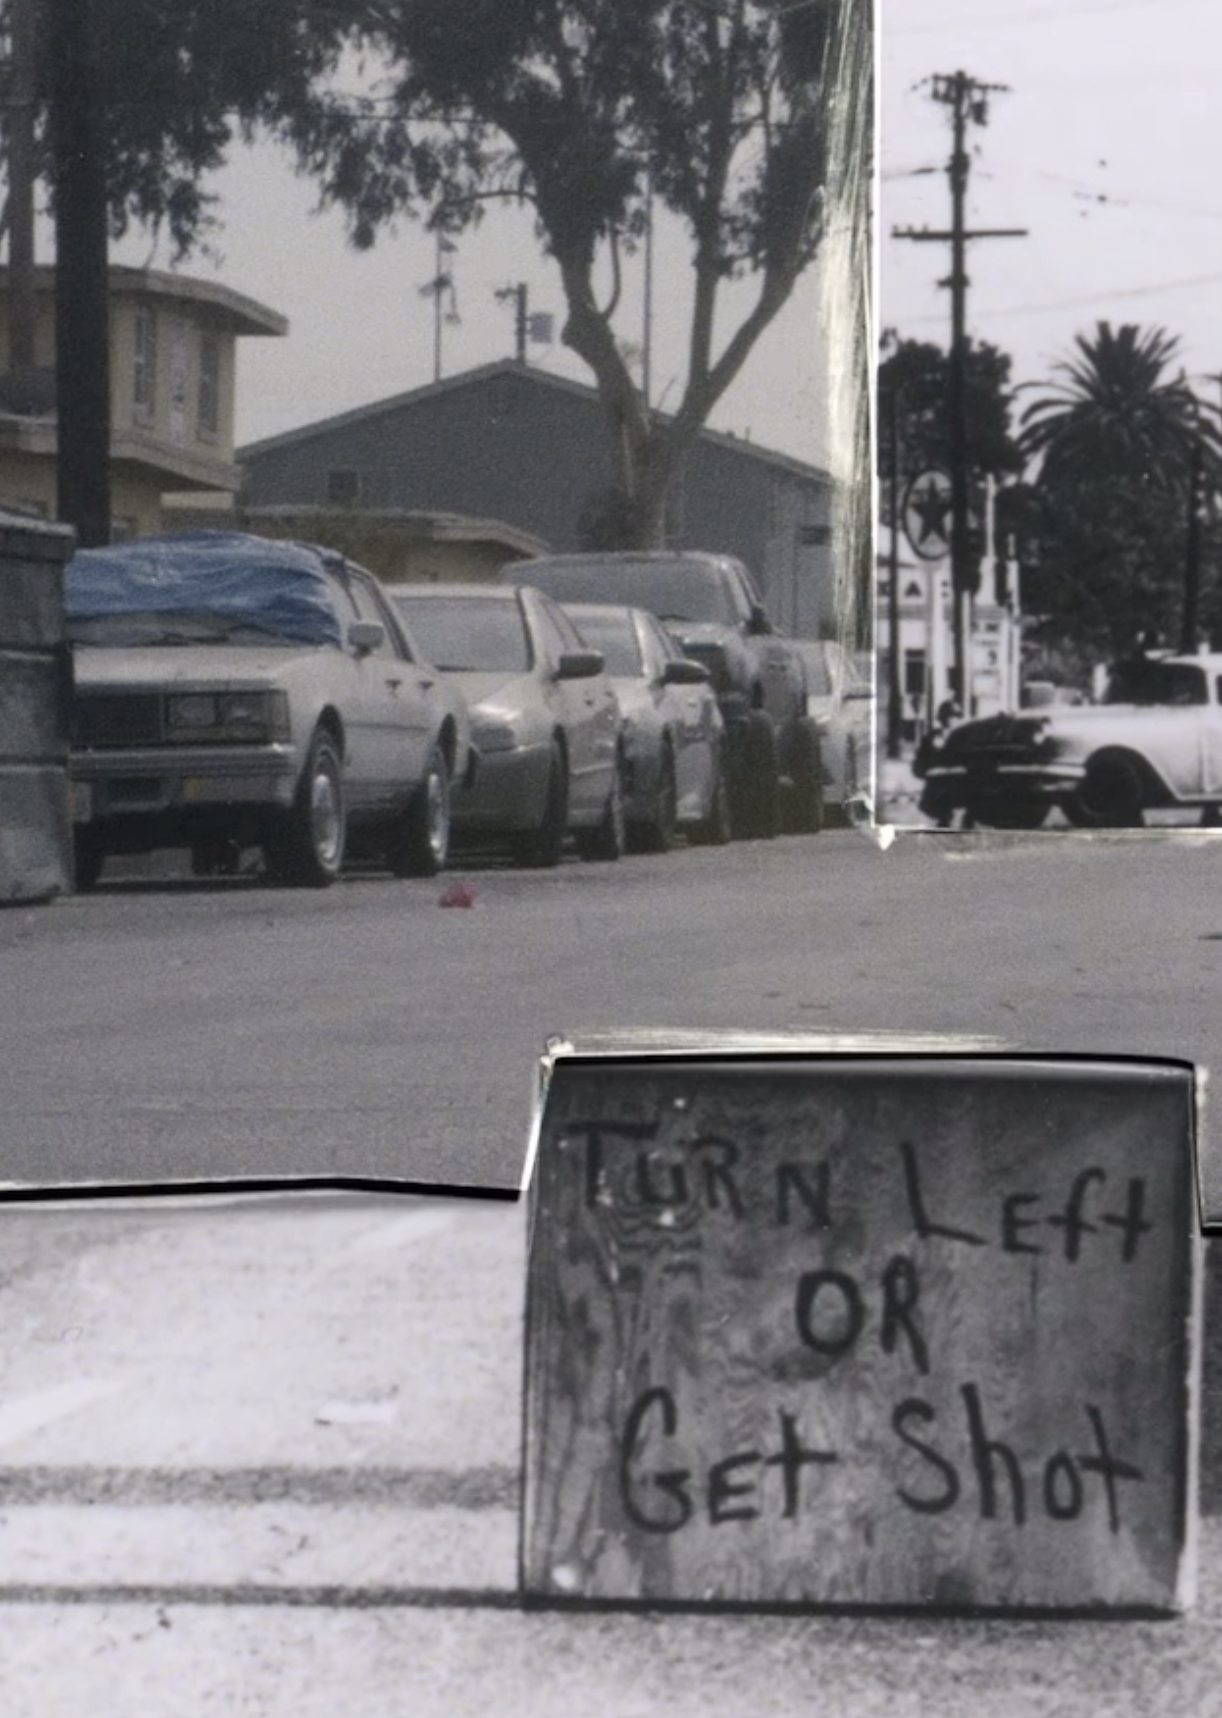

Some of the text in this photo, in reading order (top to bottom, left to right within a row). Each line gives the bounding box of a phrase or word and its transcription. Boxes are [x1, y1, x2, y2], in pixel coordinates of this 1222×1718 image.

[565, 1120, 832, 1228] TURN
[795, 1253, 930, 1375] OR
[891, 1382, 1146, 1534] Shot
